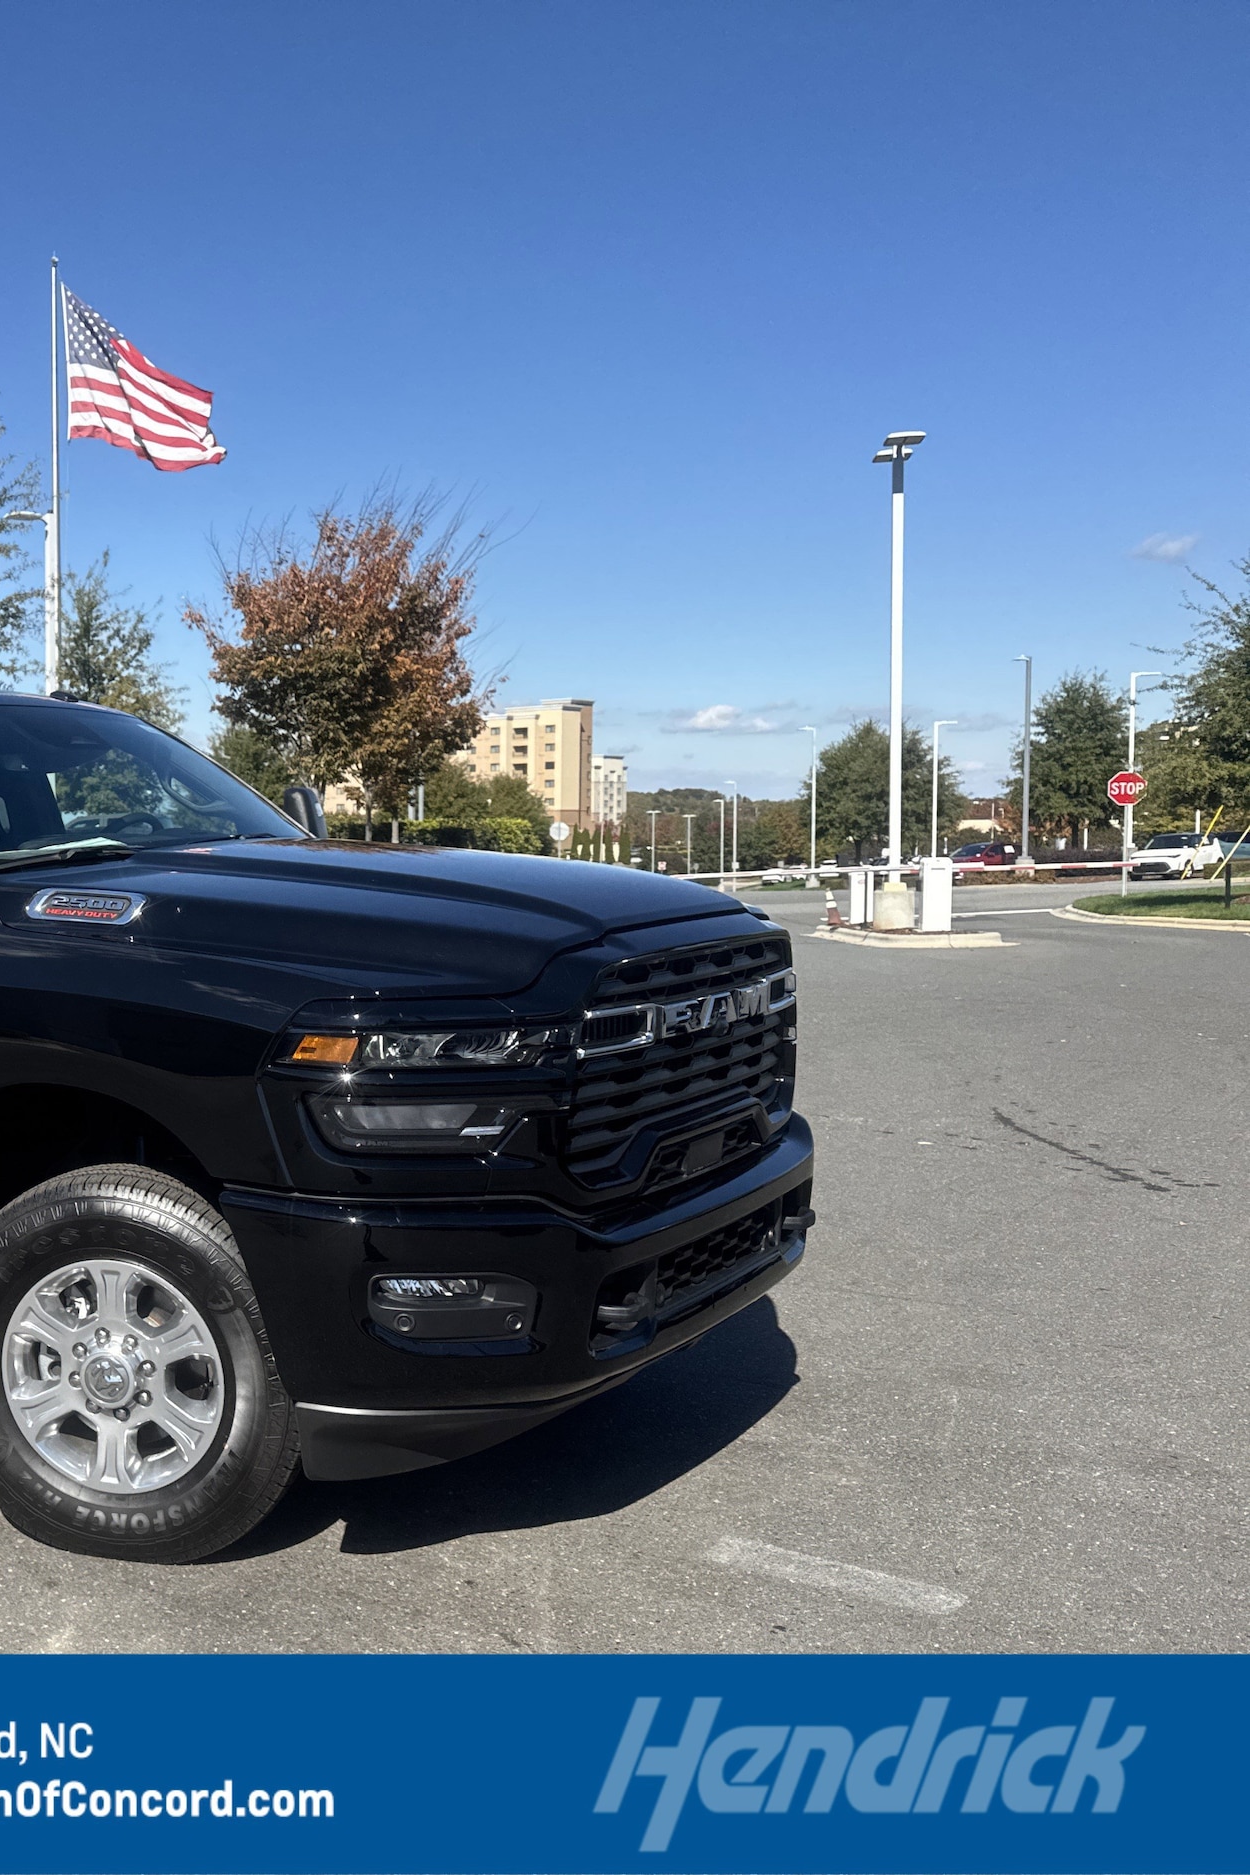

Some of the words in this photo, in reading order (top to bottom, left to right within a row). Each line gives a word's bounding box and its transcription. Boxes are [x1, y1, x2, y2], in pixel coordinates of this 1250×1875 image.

[1110, 782, 1145, 796] STOP
[52, 895, 125, 911] 2500
[45, 908, 84, 917] HEAVY
[84, 911, 118, 919] DUTY
[660, 979, 768, 1039] RAM
[72, 1449, 243, 1535] TRANSFORCE
